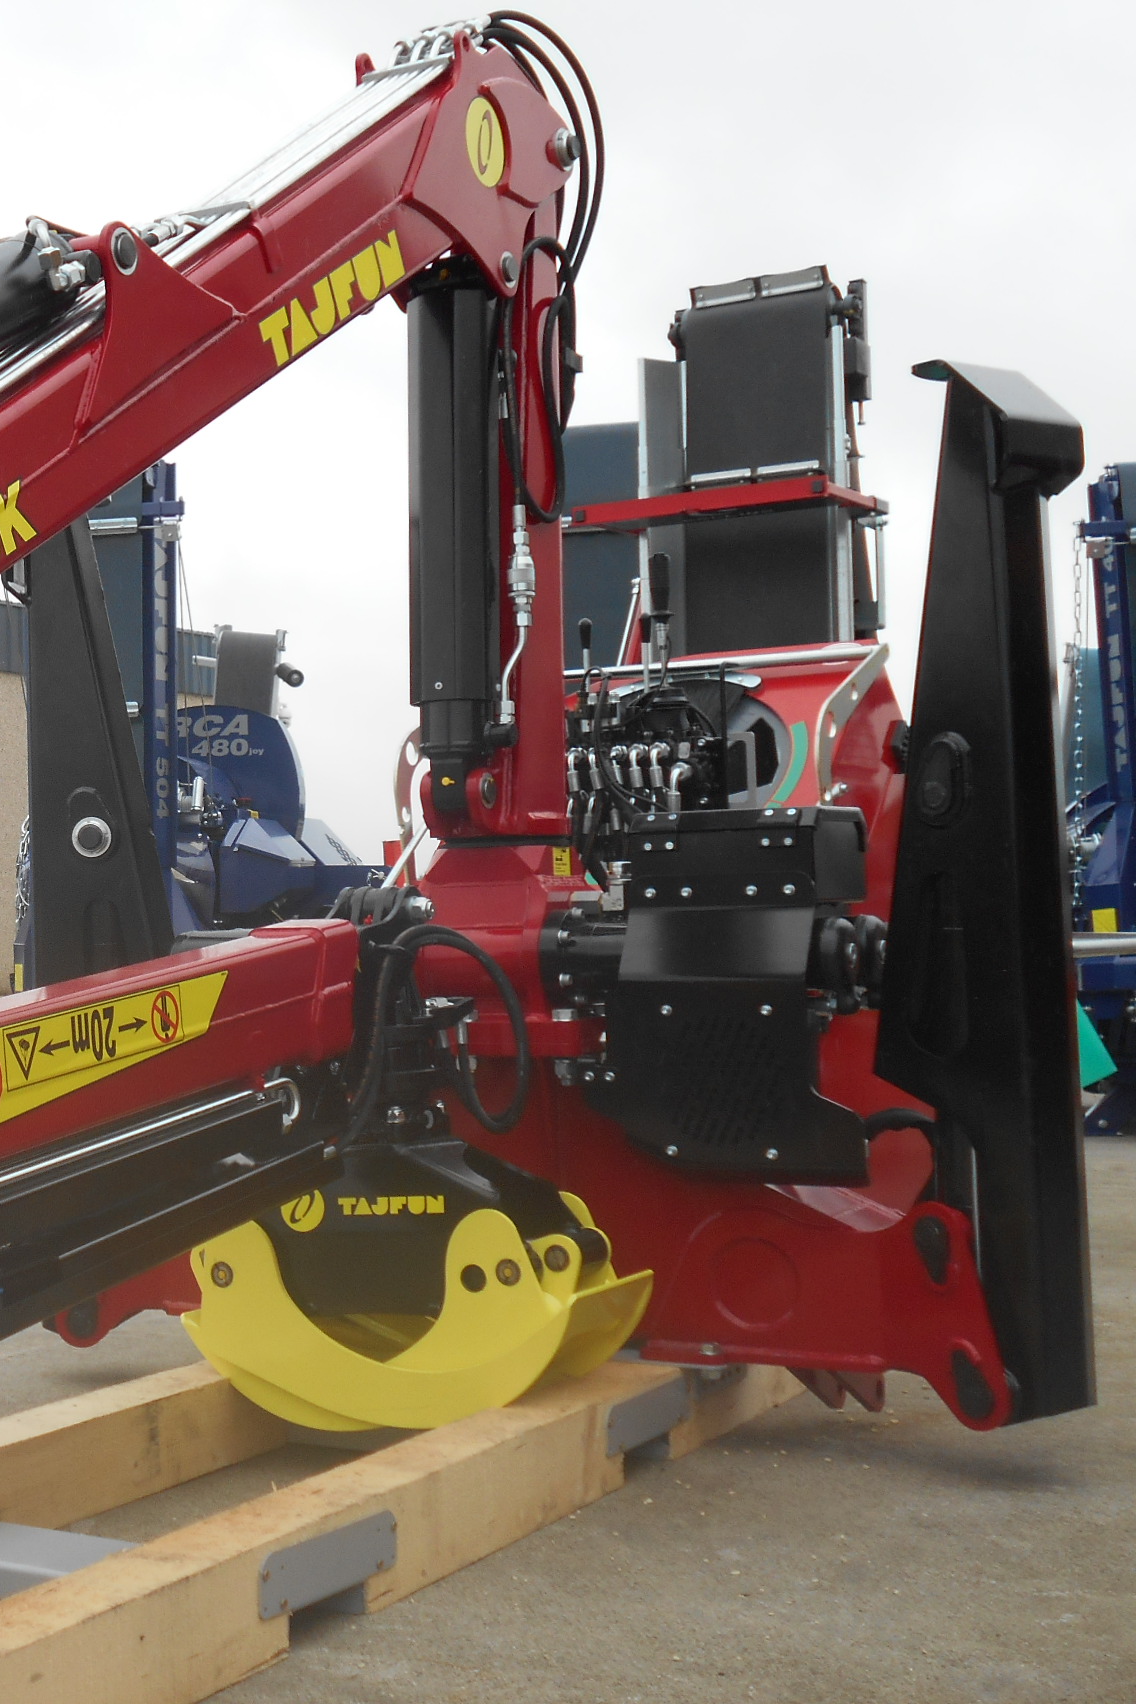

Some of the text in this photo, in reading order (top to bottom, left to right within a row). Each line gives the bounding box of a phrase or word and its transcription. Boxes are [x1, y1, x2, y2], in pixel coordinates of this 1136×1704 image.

[259, 229, 406, 367] TAJFUN
[191, 738, 249, 757] 480
[155, 757, 169, 819] 504
[70, 1005, 117, 1062] 20m
[337, 1195, 445, 1216] TAJFUN
